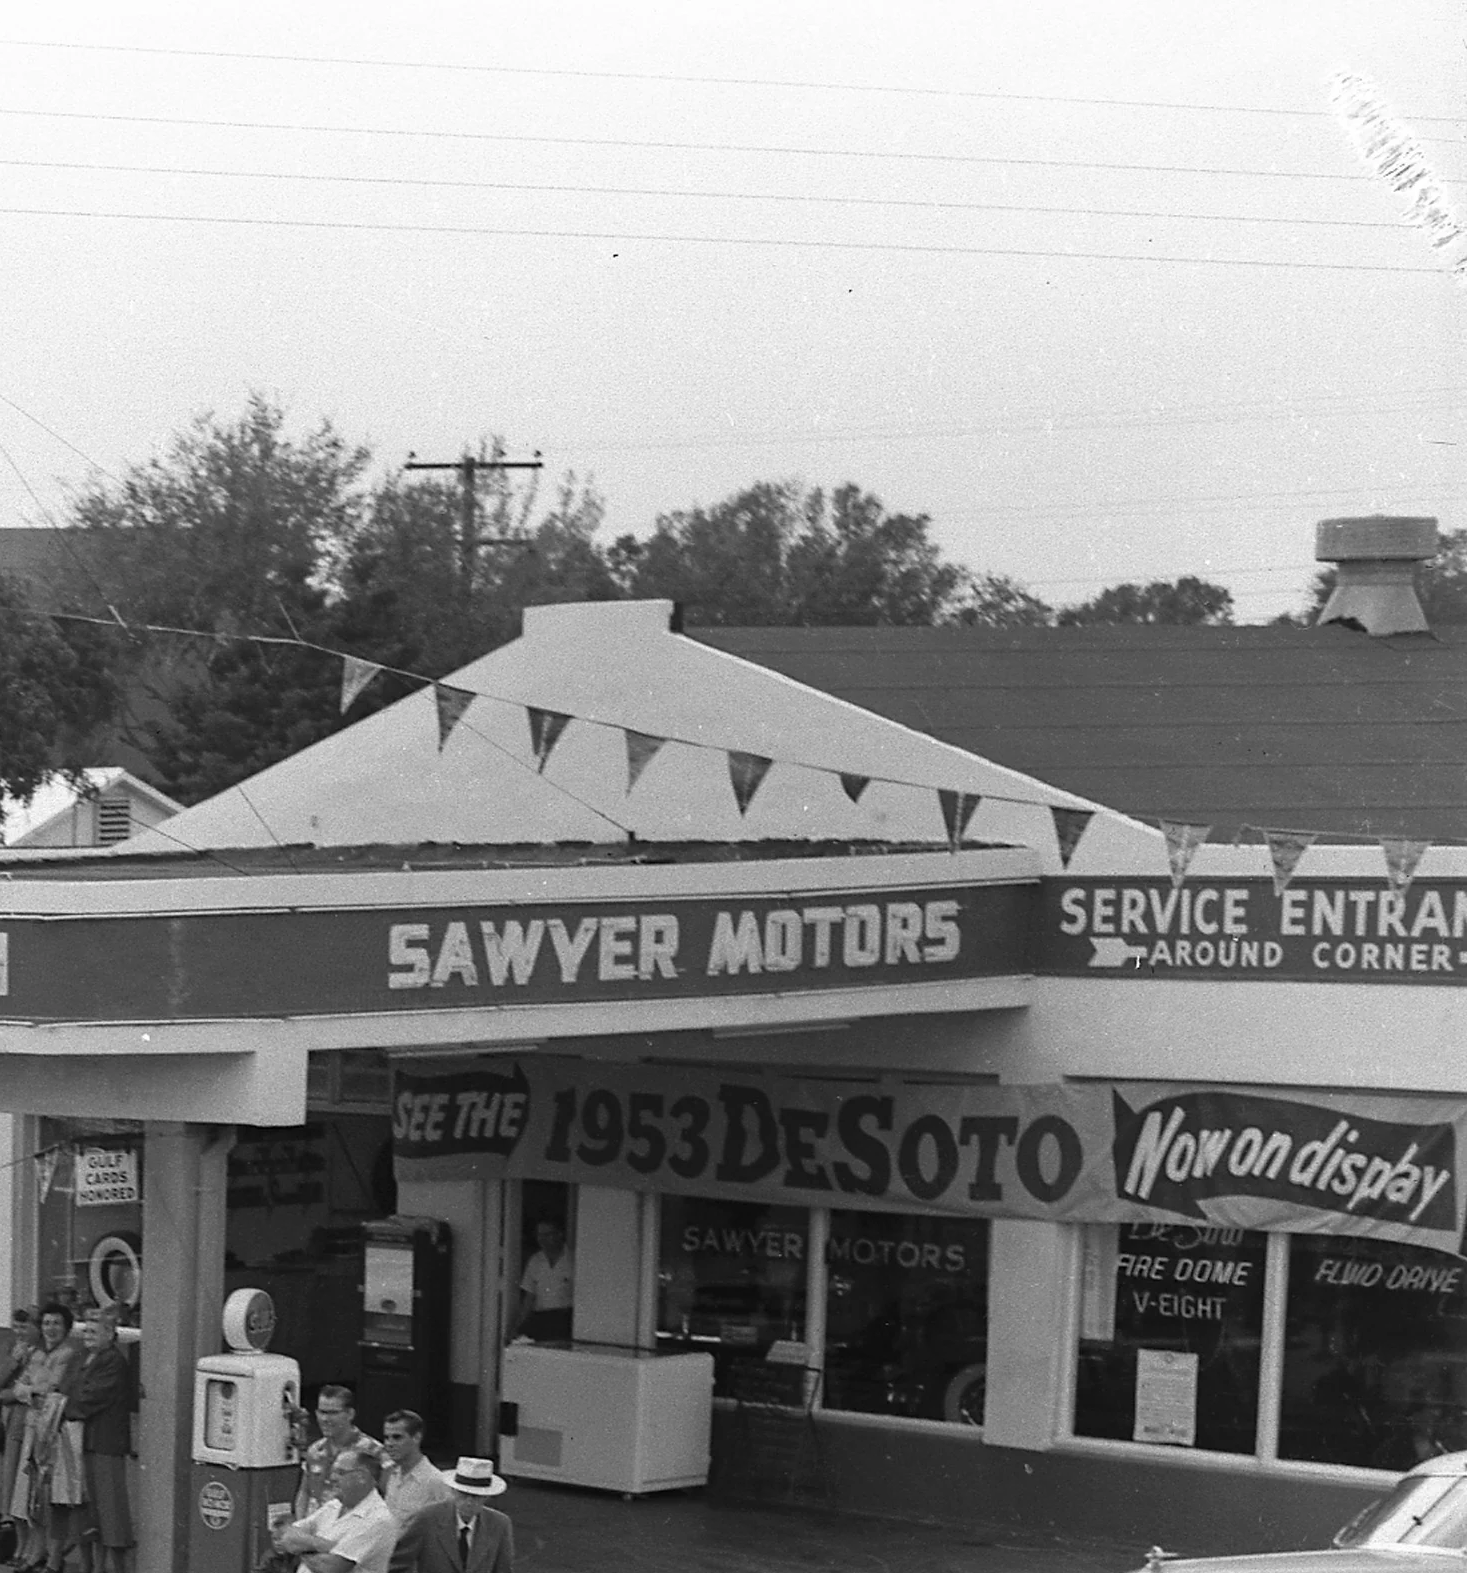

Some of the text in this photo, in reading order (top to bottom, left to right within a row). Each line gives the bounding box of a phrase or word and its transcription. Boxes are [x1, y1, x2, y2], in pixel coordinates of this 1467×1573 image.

[1060, 888, 1250, 935] SERVICE
[389, 901, 961, 989] SAWYER MOTORS
[1148, 940, 1454, 971] AROUND CORNER
[89, 1154, 122, 1169] GULF
[393, 1091, 447, 1142] SEE
[454, 1091, 527, 1139] THE
[545, 1088, 711, 1179] 1953
[1124, 1106, 1231, 1199] Now
[1228, 1127, 1292, 1180] on
[1288, 1119, 1449, 1221] display
[87, 1171, 128, 1185] CARDS
[80, 1187, 135, 1201] HONORED
[682, 1226, 965, 1271] SAWYER MOTORS
[1174, 1258, 1253, 1286] DOME
[1314, 1258, 1462, 1293] FLUID DRIVE
[1132, 1291, 1227, 1320] V-EIGHT
